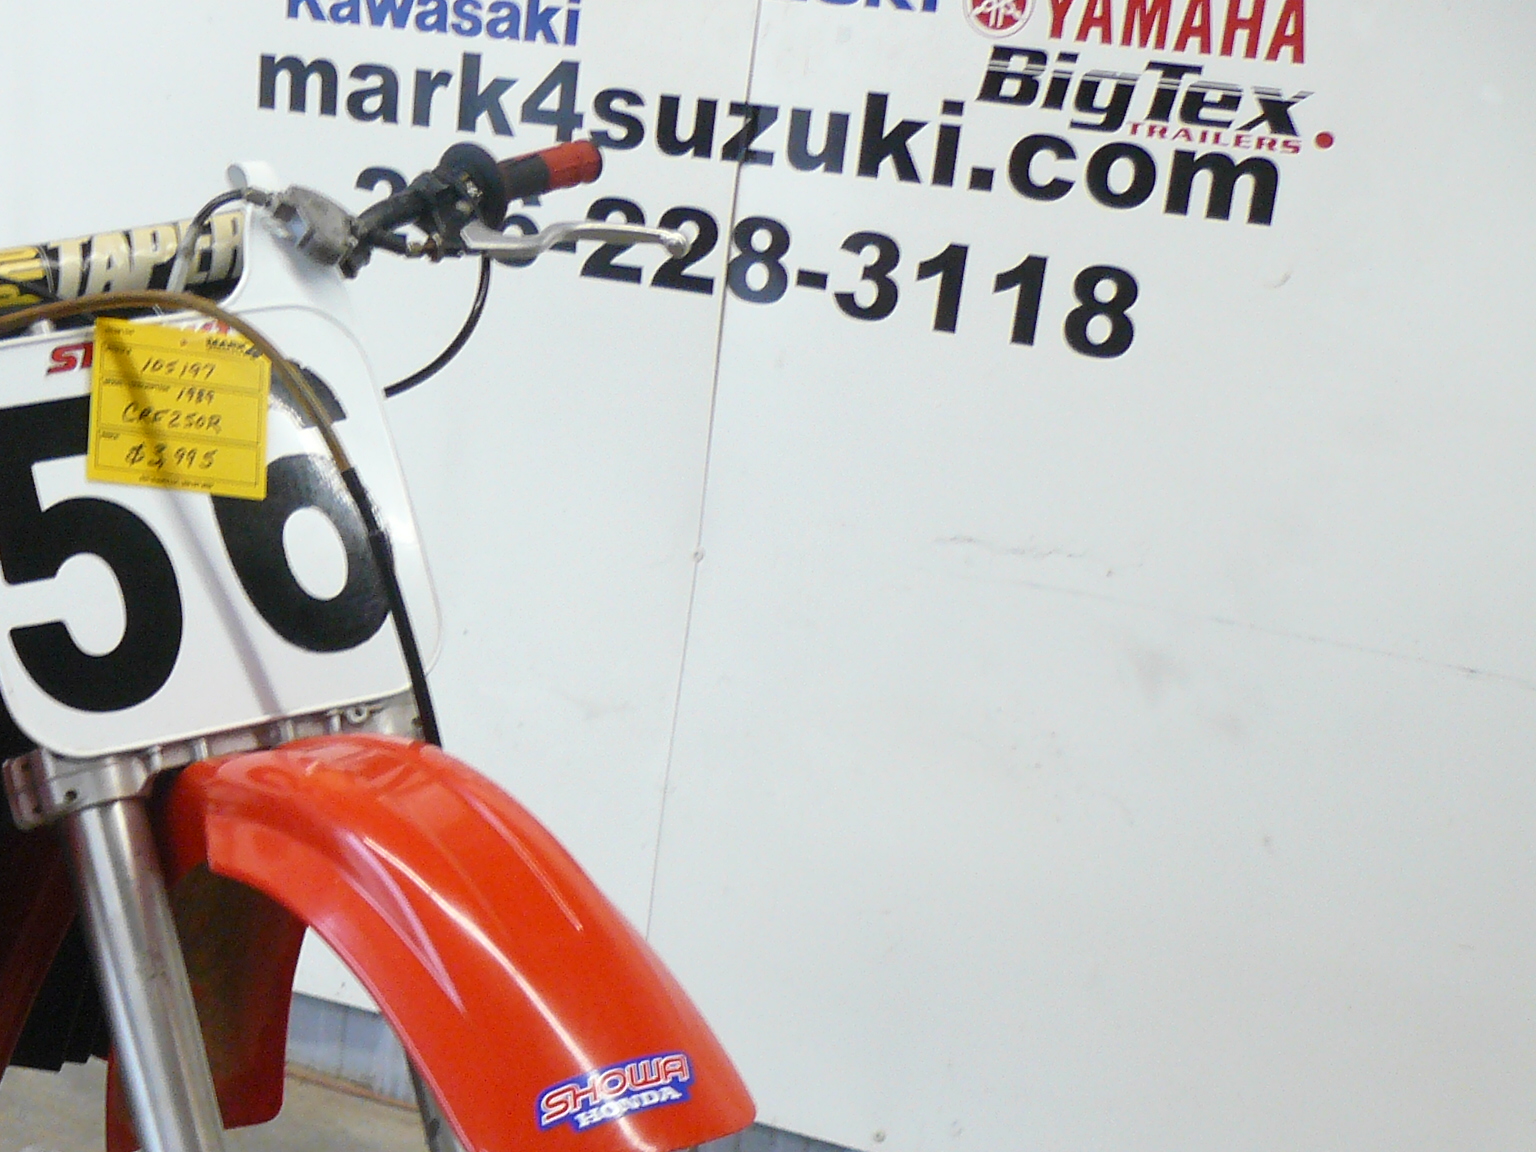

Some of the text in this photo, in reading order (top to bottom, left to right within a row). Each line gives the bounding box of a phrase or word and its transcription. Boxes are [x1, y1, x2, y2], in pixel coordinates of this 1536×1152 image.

[1046, 0, 1306, 64] YAMAHA
[258, 51, 1281, 226] mark4suzuki.com
[1126, 121, 1302, 154] TRAILERS
[541, 1053, 690, 1126] SHOWA
[574, 1086, 682, 1129] HONDA
